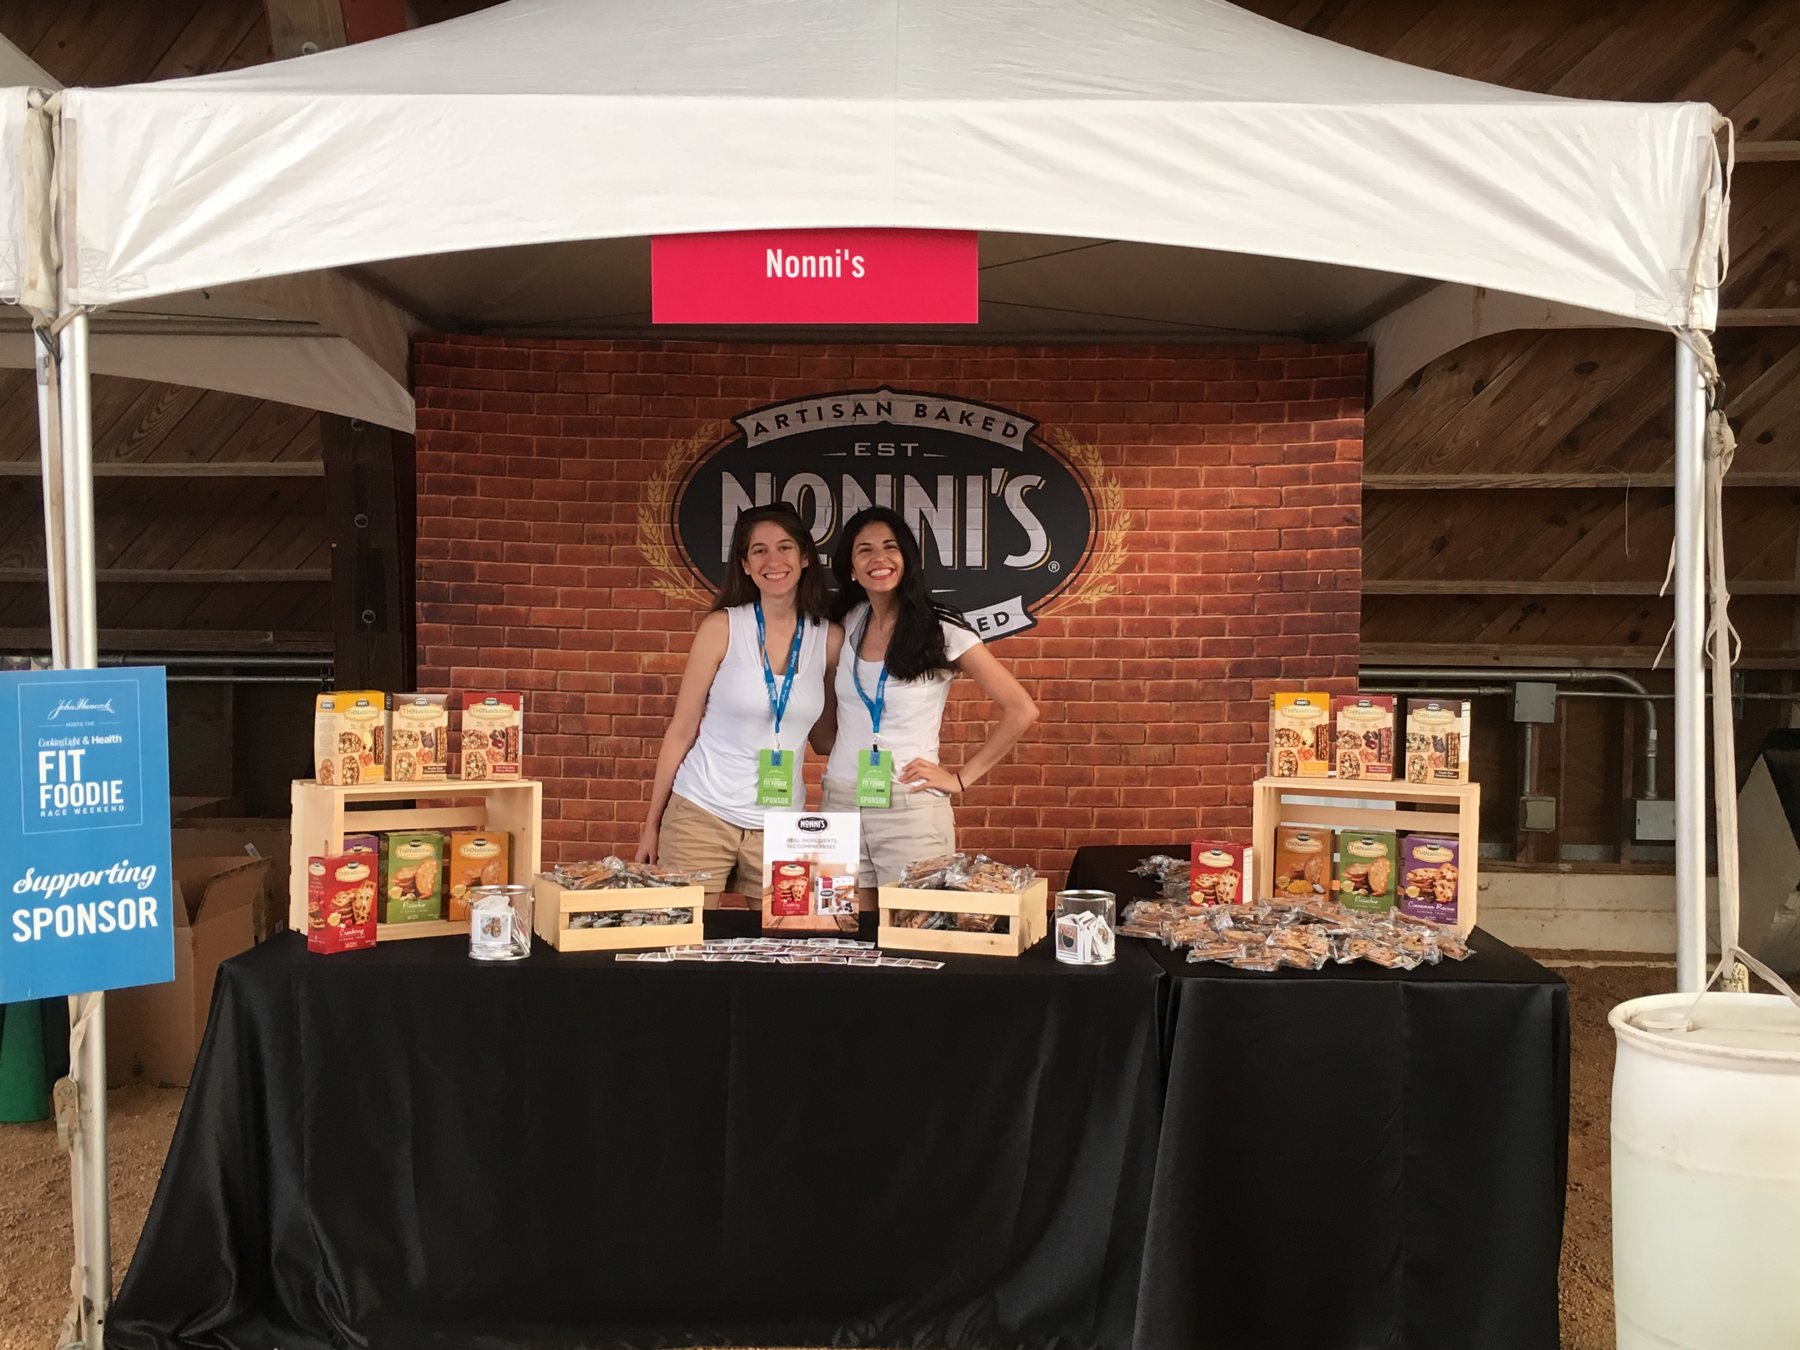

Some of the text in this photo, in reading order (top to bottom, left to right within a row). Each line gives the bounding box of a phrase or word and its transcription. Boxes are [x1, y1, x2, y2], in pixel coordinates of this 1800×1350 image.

[766, 248, 865, 279] Nonni's
[753, 401, 1019, 439] ARTISAN BAKED
[854, 442, 919, 457] EST
[82, 735, 90, 745] &
[91, 734, 122, 745] Health
[38, 748, 86, 784] FIT
[40, 780, 124, 809] FOODIE
[762, 796, 789, 805] SPONSOR
[860, 796, 887, 805] SPONSOR
[40, 804, 125, 818] RACE WEEKEND
[800, 820, 826, 829] NONNI'S
[12, 859, 157, 899] Supporting
[12, 896, 158, 943] SPONSOR
